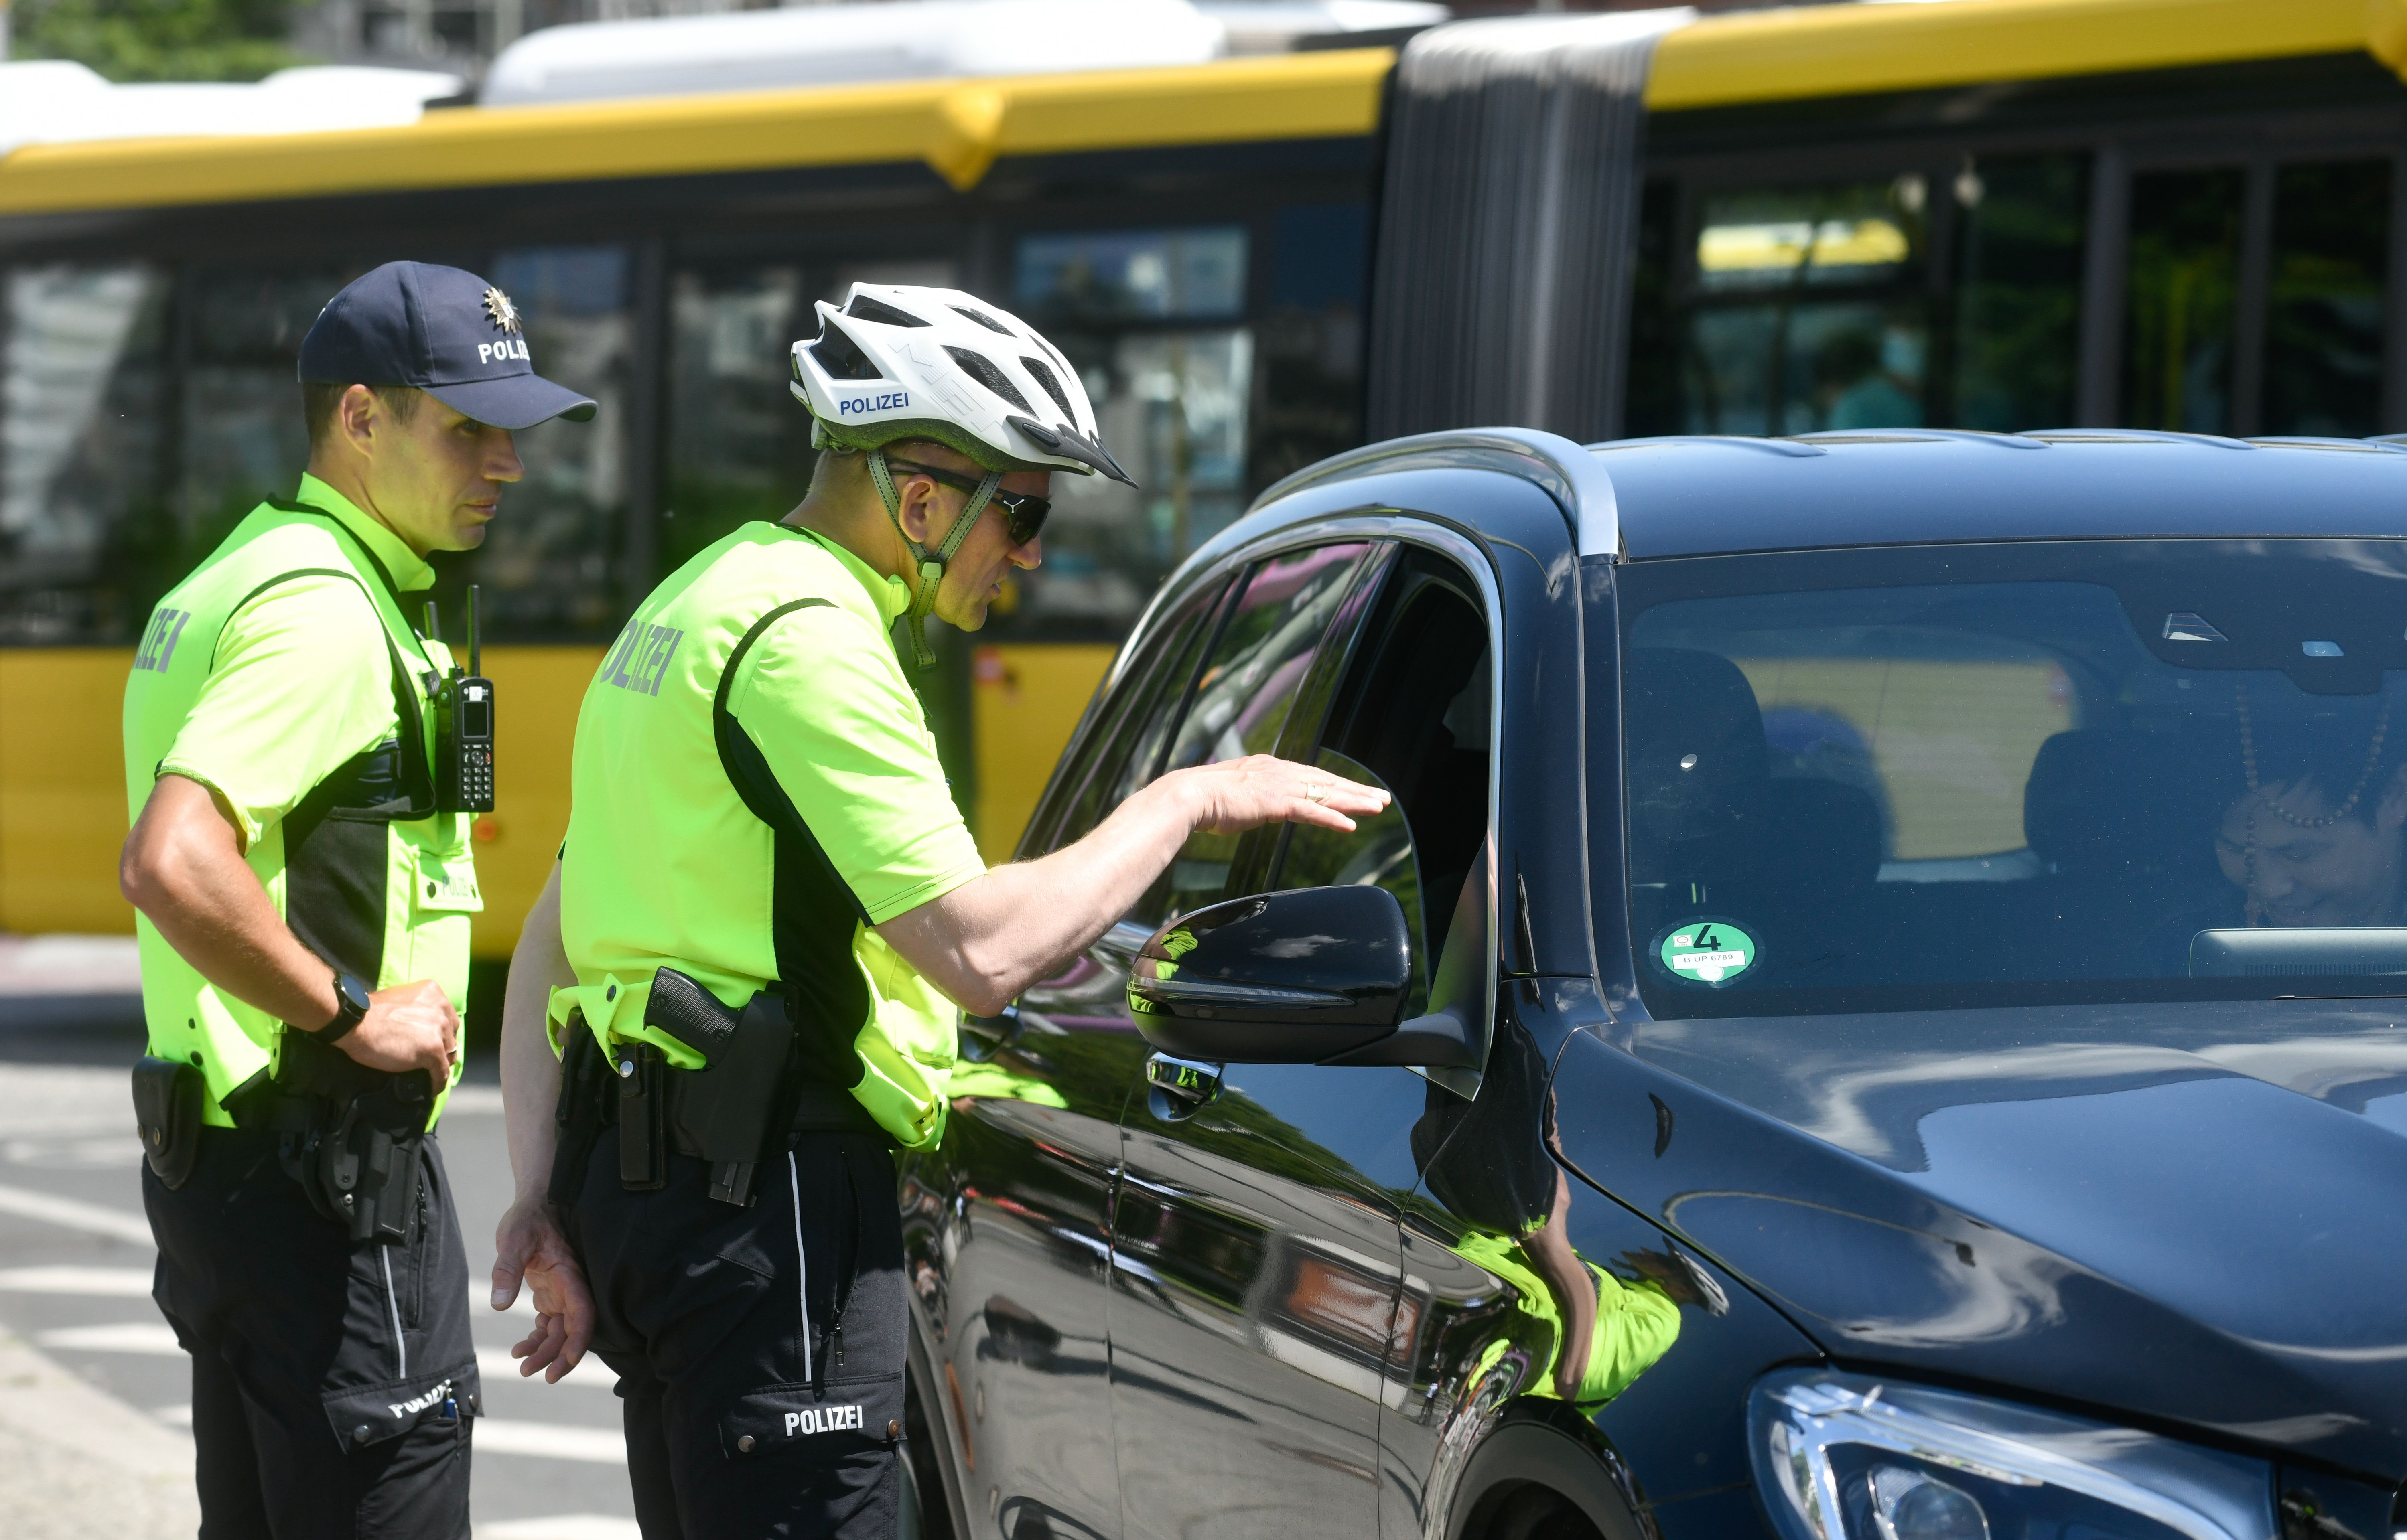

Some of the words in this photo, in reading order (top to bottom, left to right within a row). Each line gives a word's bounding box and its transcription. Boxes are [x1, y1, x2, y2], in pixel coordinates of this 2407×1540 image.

[840, 392, 909, 415] POLIZEI
[599, 618, 684, 697] OLIZEI
[1693, 924, 1721, 951] 4
[784, 1405, 863, 1437] POLIZEI
